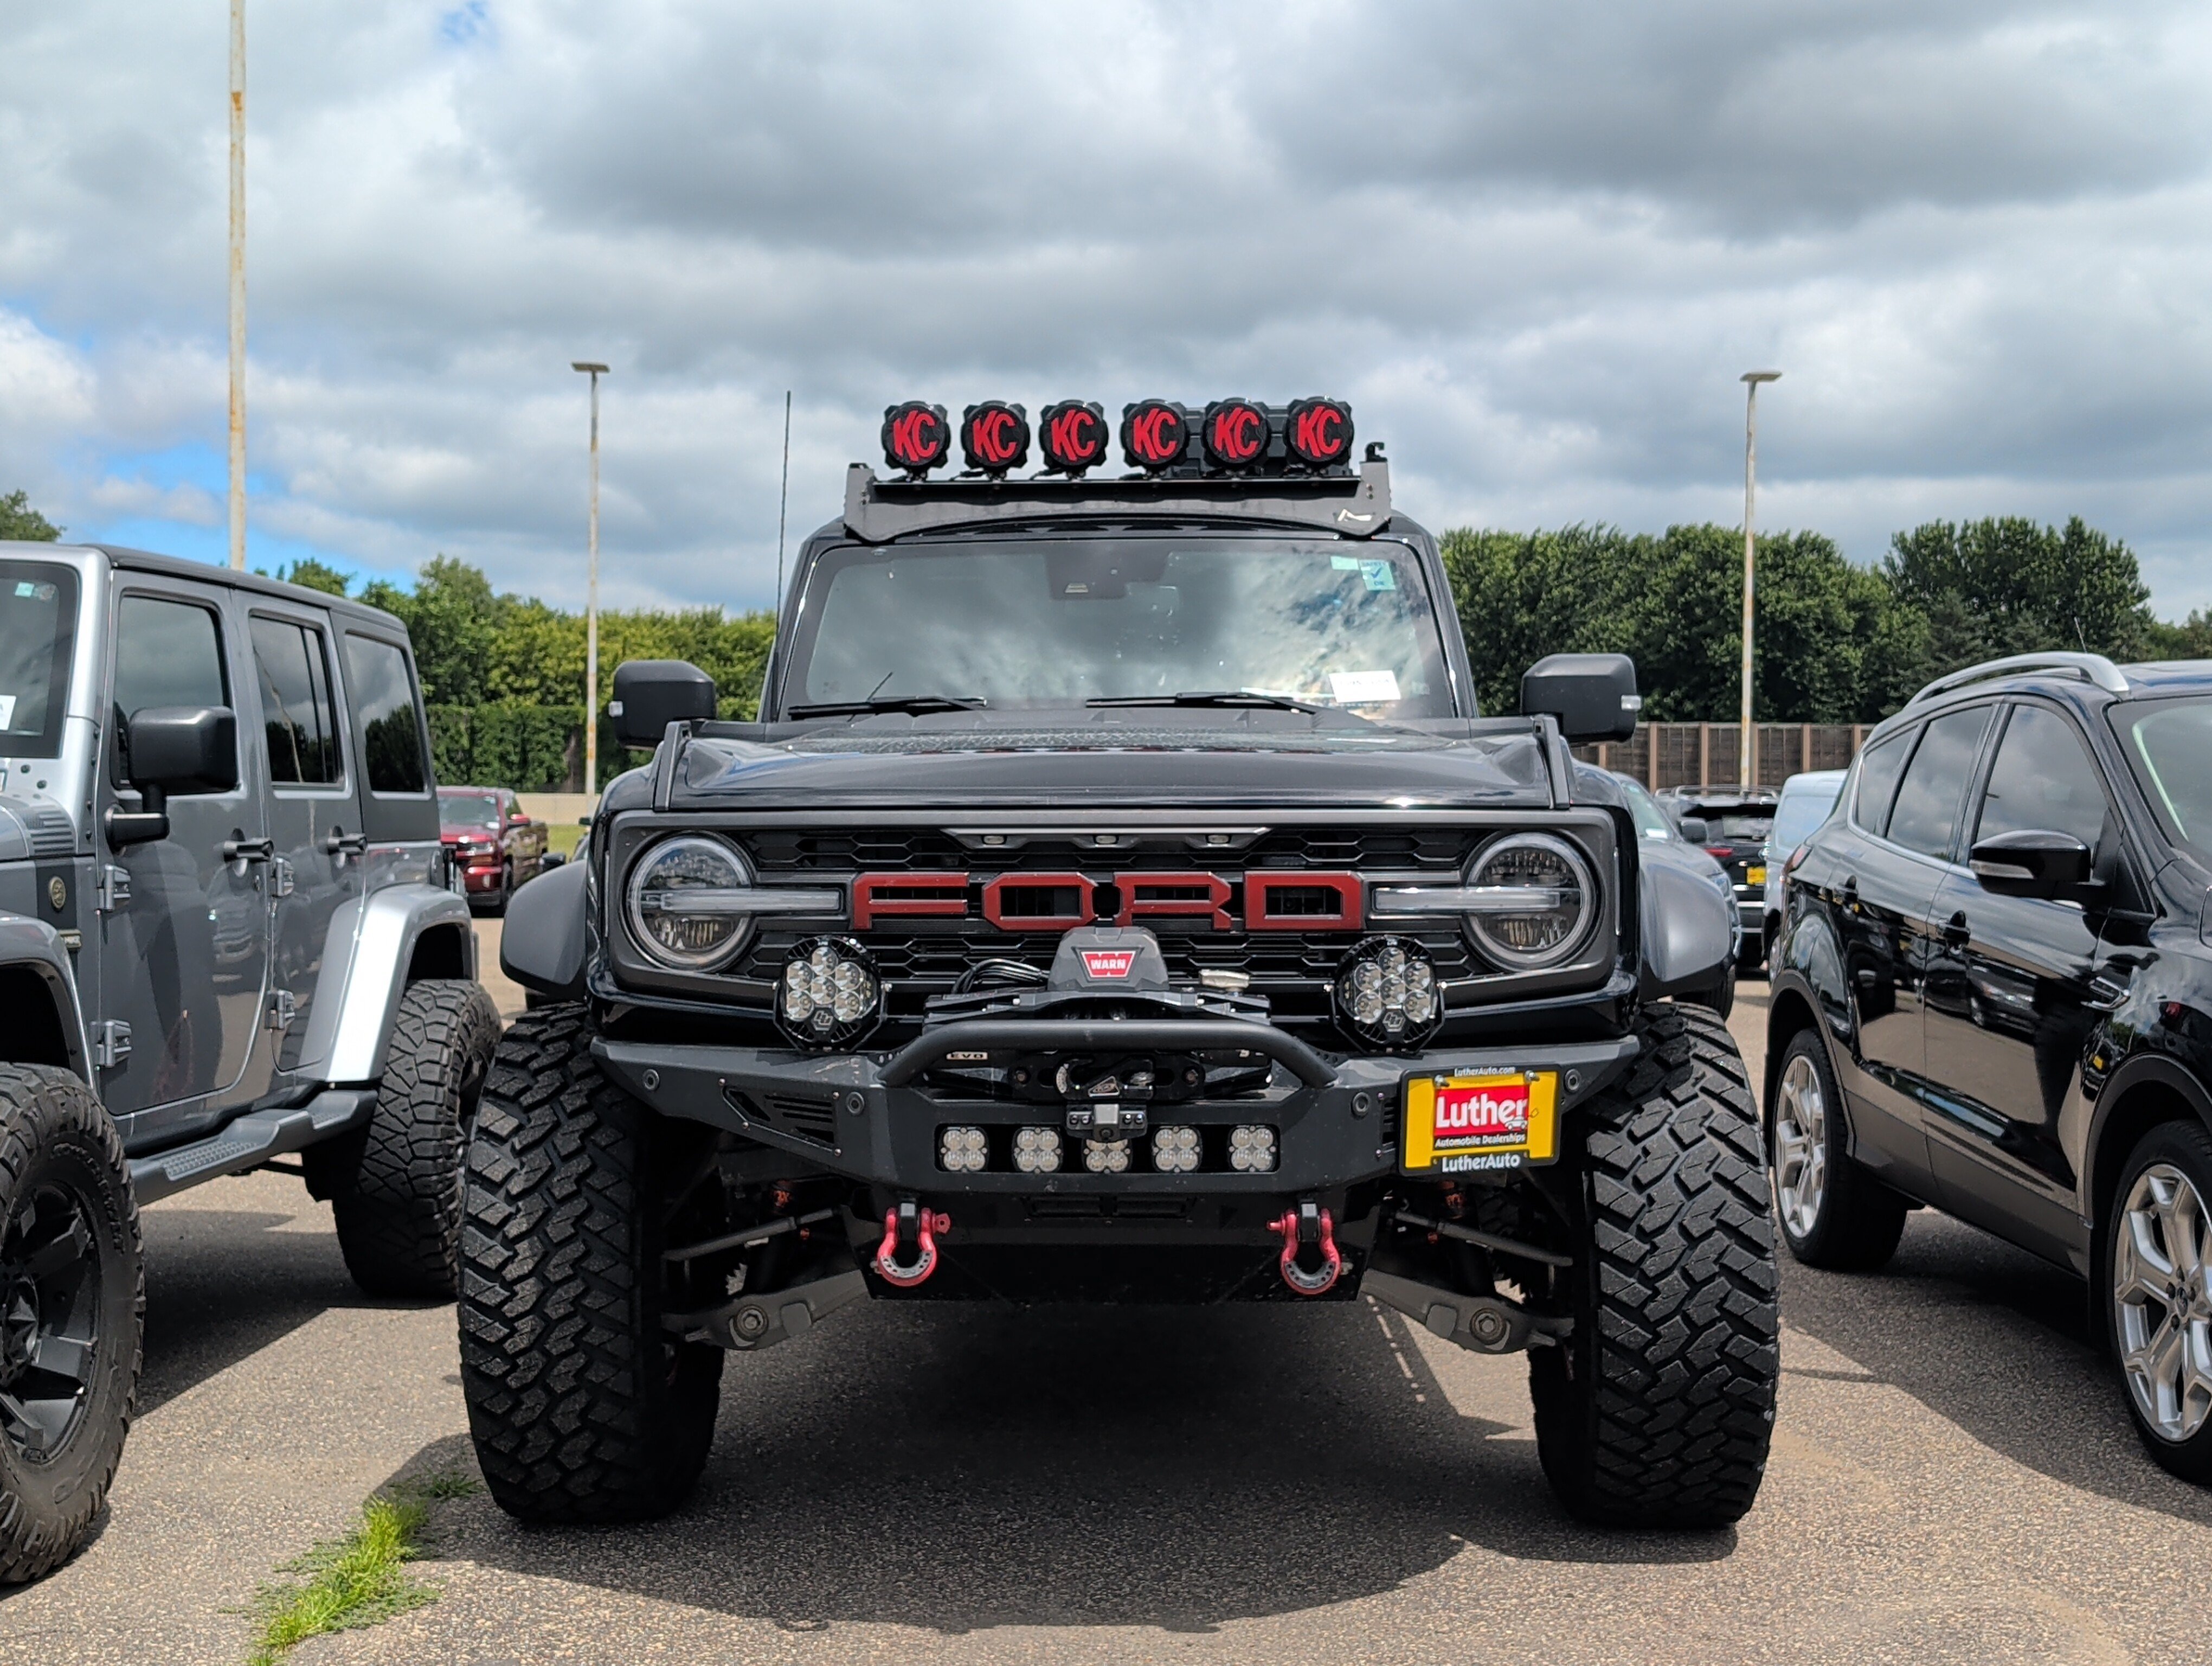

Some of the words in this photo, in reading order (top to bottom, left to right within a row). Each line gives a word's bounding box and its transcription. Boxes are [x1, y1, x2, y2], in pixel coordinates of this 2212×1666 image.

[892, 409, 938, 462] KC
[972, 410, 1017, 462] KC
[1051, 409, 1096, 462] KC
[1133, 407, 1177, 462] KC
[1213, 407, 1259, 459] KC
[1297, 405, 1342, 458] KC
[853, 872, 1362, 931] FORD
[1090, 959, 1126, 970] WARN
[1454, 1066, 1516, 1078] LutherAuto.com
[1435, 1093, 1528, 1129] Luther
[1435, 1136, 1481, 1148] Automobile
[1482, 1133, 1526, 1146] Dealerships
[1442, 1153, 1521, 1173] LutherAuto
